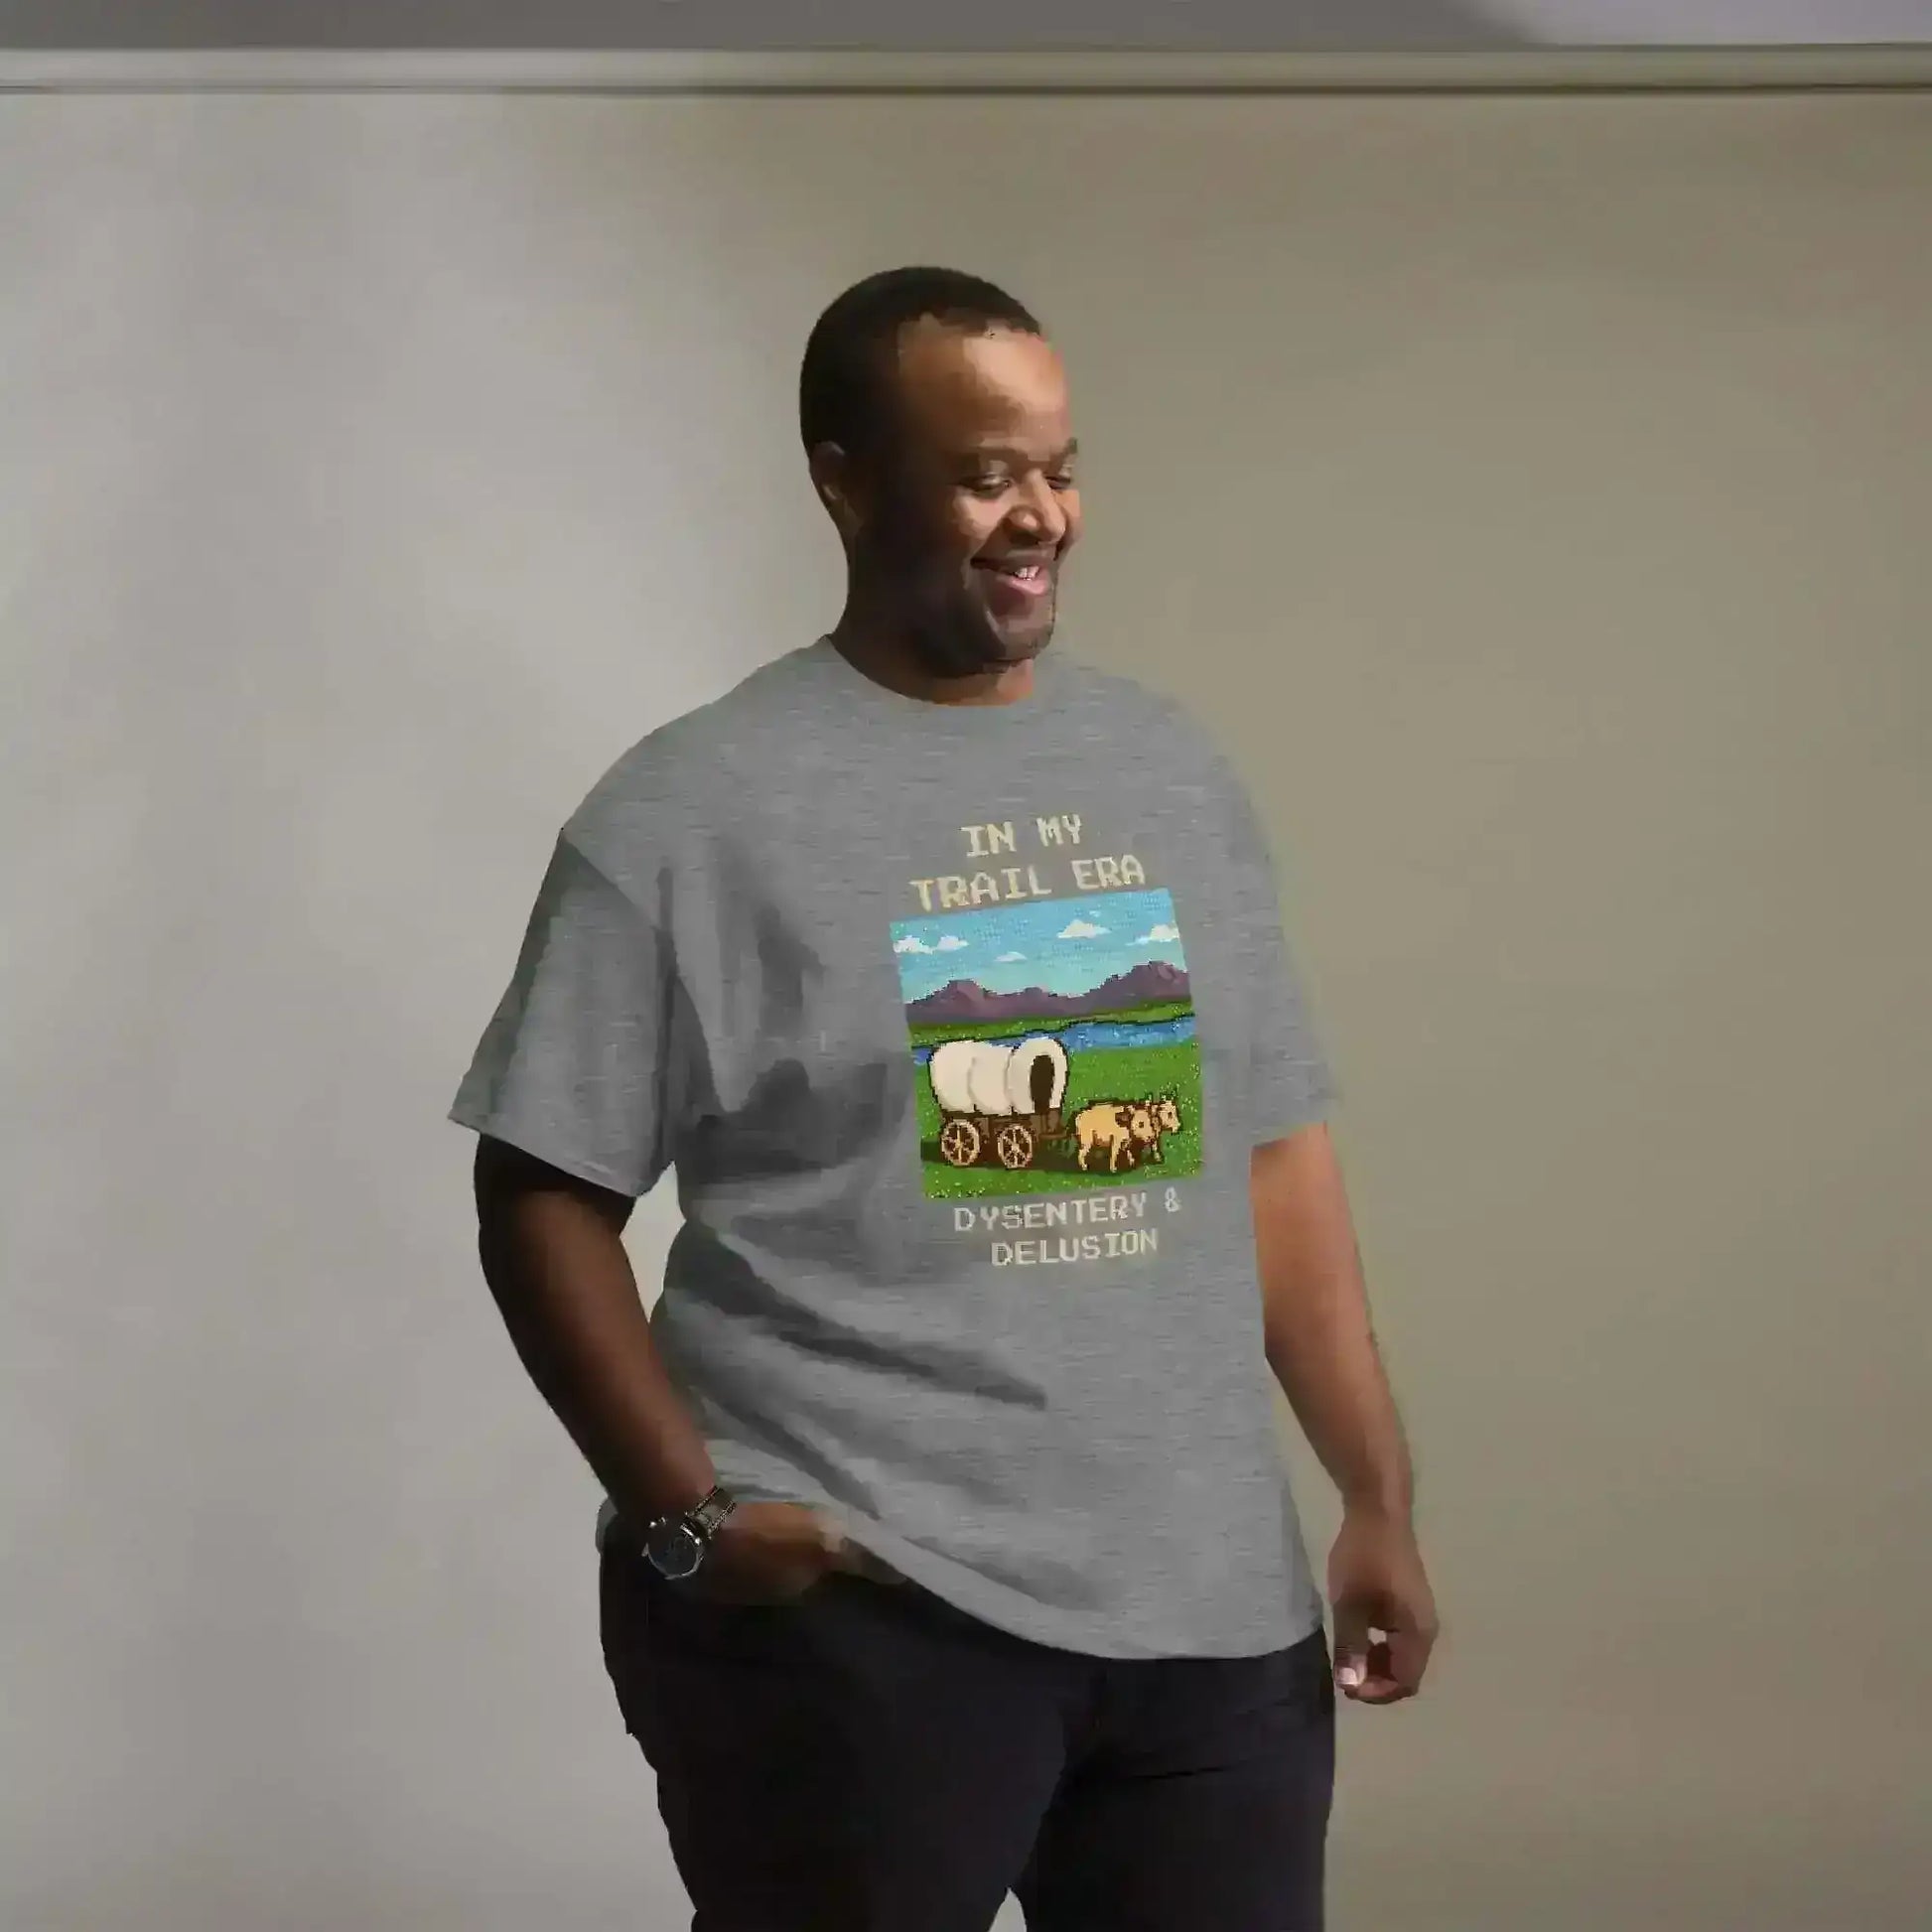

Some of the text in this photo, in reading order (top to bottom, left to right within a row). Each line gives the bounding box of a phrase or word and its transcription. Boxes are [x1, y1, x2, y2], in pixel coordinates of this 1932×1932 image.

[960, 814, 1082, 857] IN MY
[909, 854, 1146, 912] TRAIL ERA
[954, 1186, 1181, 1232] DYSENTERY &
[991, 1229, 1159, 1267] DELUSION
